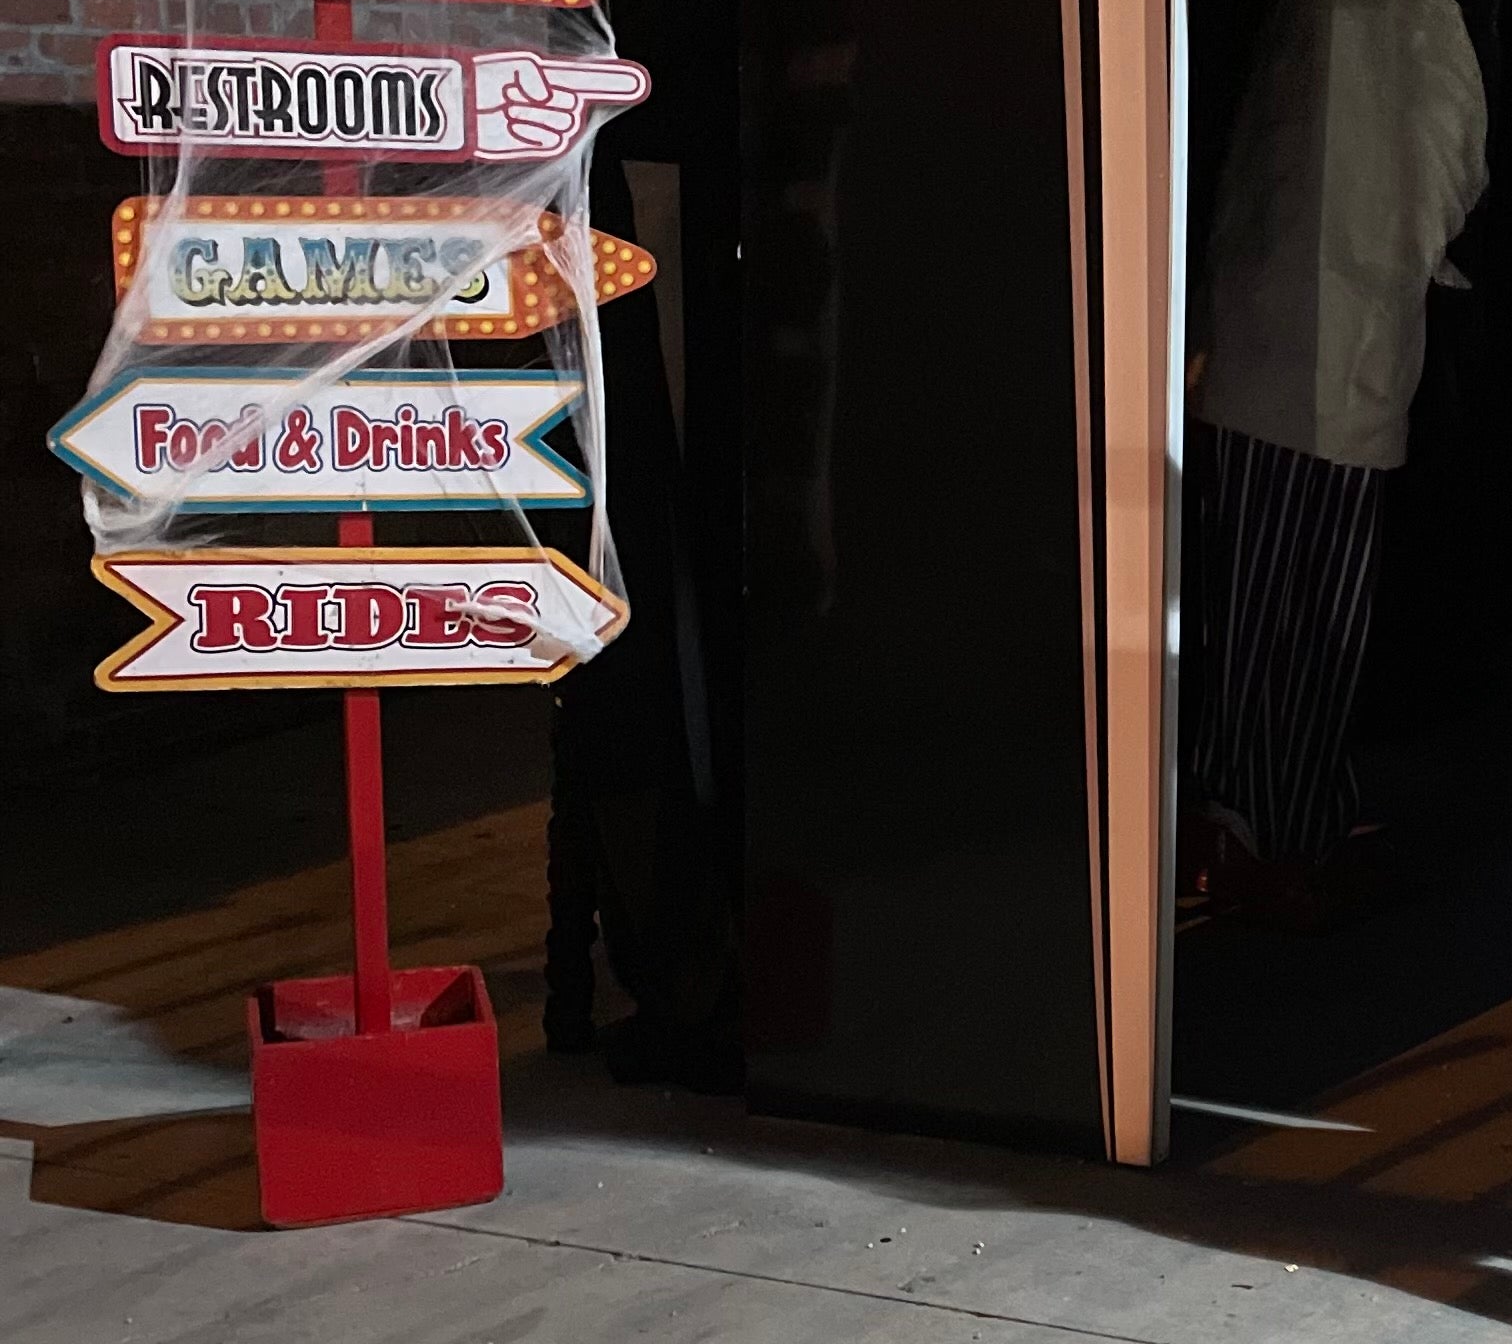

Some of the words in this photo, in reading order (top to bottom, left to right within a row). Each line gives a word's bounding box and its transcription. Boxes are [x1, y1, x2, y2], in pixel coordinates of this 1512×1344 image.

[126, 54, 446, 141] RESTROOMS
[171, 235, 490, 305] GAMES
[273, 408, 323, 473] &
[331, 404, 510, 473] Drinks
[189, 582, 540, 653] RIDES
